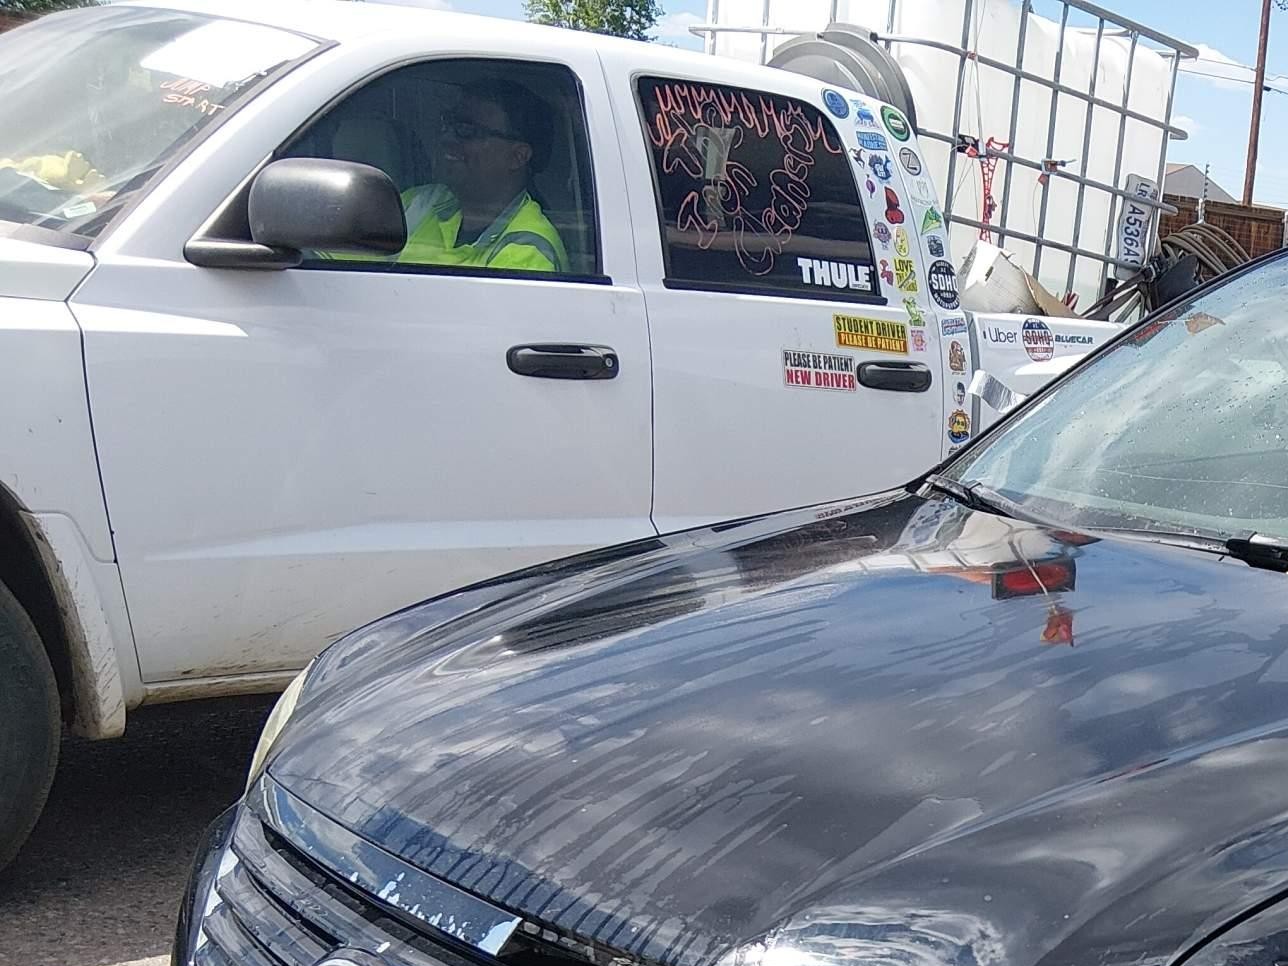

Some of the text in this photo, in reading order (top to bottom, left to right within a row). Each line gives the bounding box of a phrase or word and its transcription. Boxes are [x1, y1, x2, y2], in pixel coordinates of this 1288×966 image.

[160, 79, 210, 95] JUMP
[163, 94, 225, 115] START
[797, 257, 872, 291] THULE
[893, 258, 914, 272] LOVE
[836, 316, 906, 339] STUDENT DRIVER
[988, 326, 1018, 343] Uber
[841, 333, 867, 346] PLEASE
[867, 337, 877, 348] BE
[877, 338, 905, 352] PATIENT
[1055, 334, 1094, 345] BLUECAR
[784, 351, 853, 373] PLEASE BE PATIENT
[786, 369, 855, 390] NEW DRIVER
